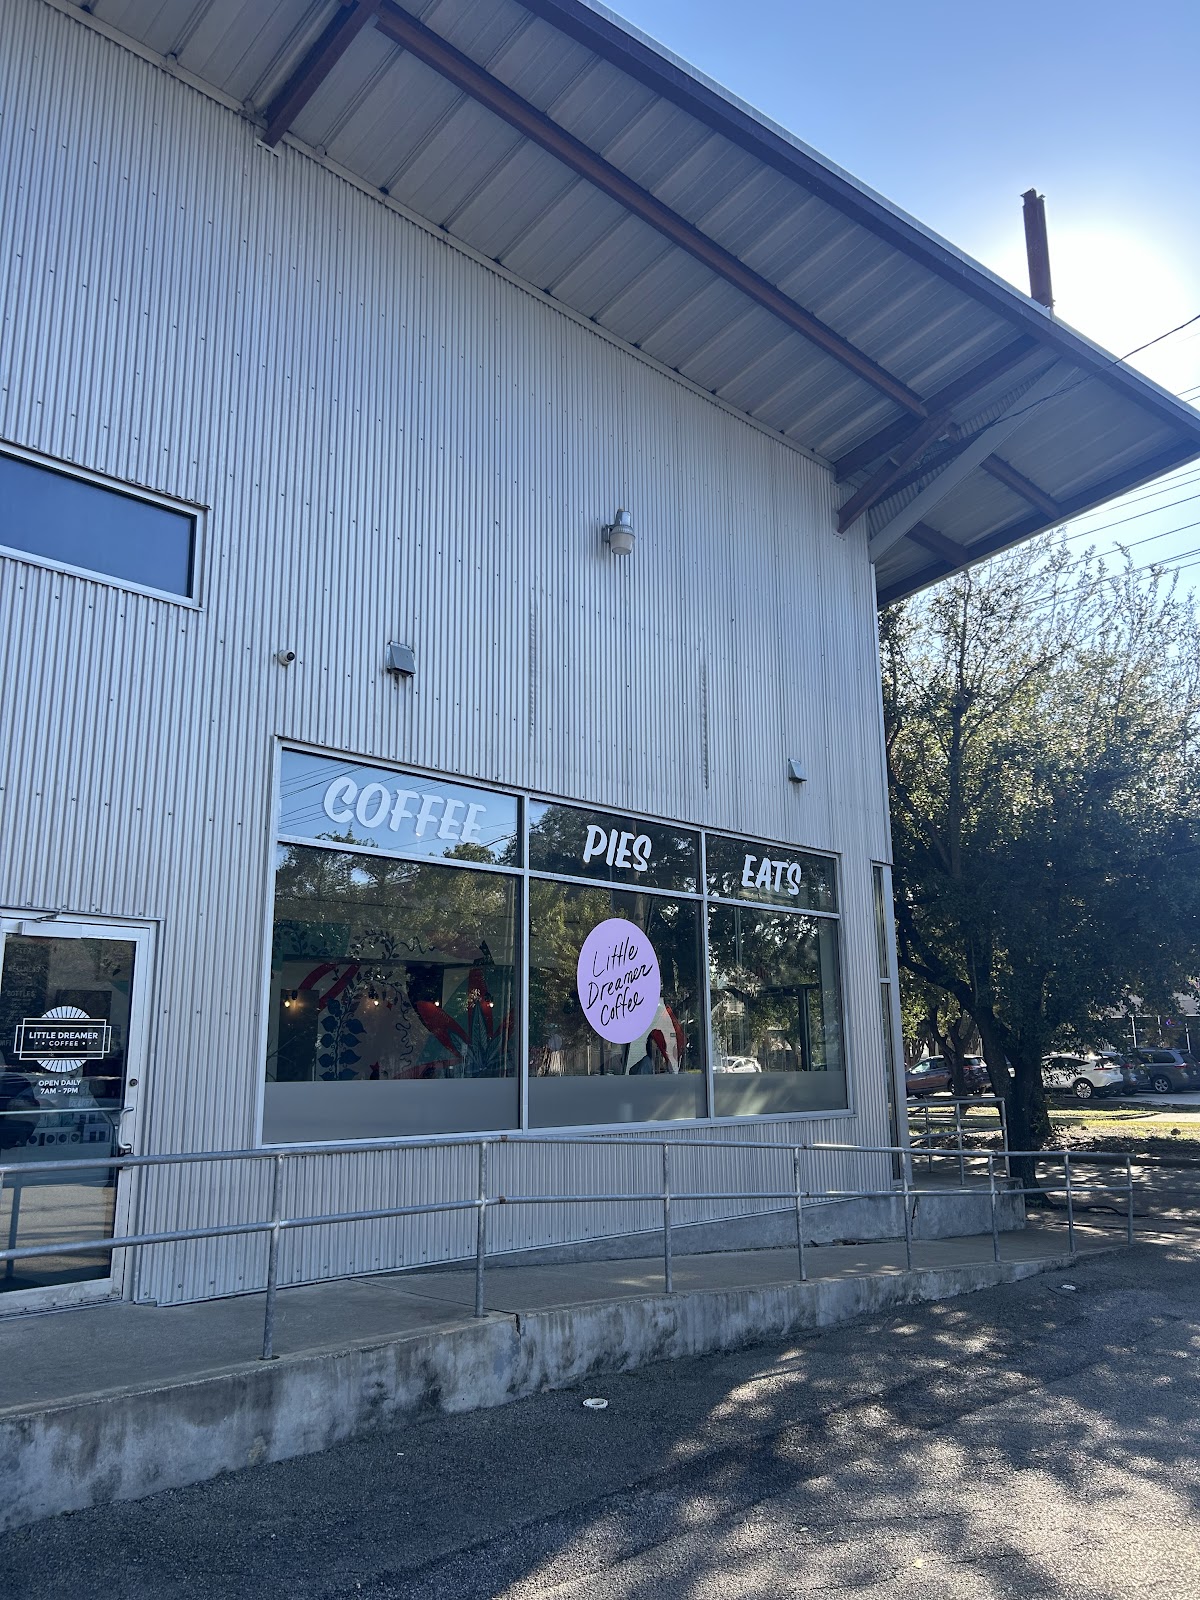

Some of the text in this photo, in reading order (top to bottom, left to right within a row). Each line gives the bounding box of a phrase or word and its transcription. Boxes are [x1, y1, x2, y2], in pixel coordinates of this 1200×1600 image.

[323, 776, 486, 844] COFFEE
[582, 824, 652, 872] PIES
[741, 853, 802, 896] EATS
[592, 936, 639, 978] Little
[586, 963, 653, 1010] Dreamer
[600, 986, 645, 1026] Coffee
[28, 1031, 99, 1040] LITTLE DREAMER
